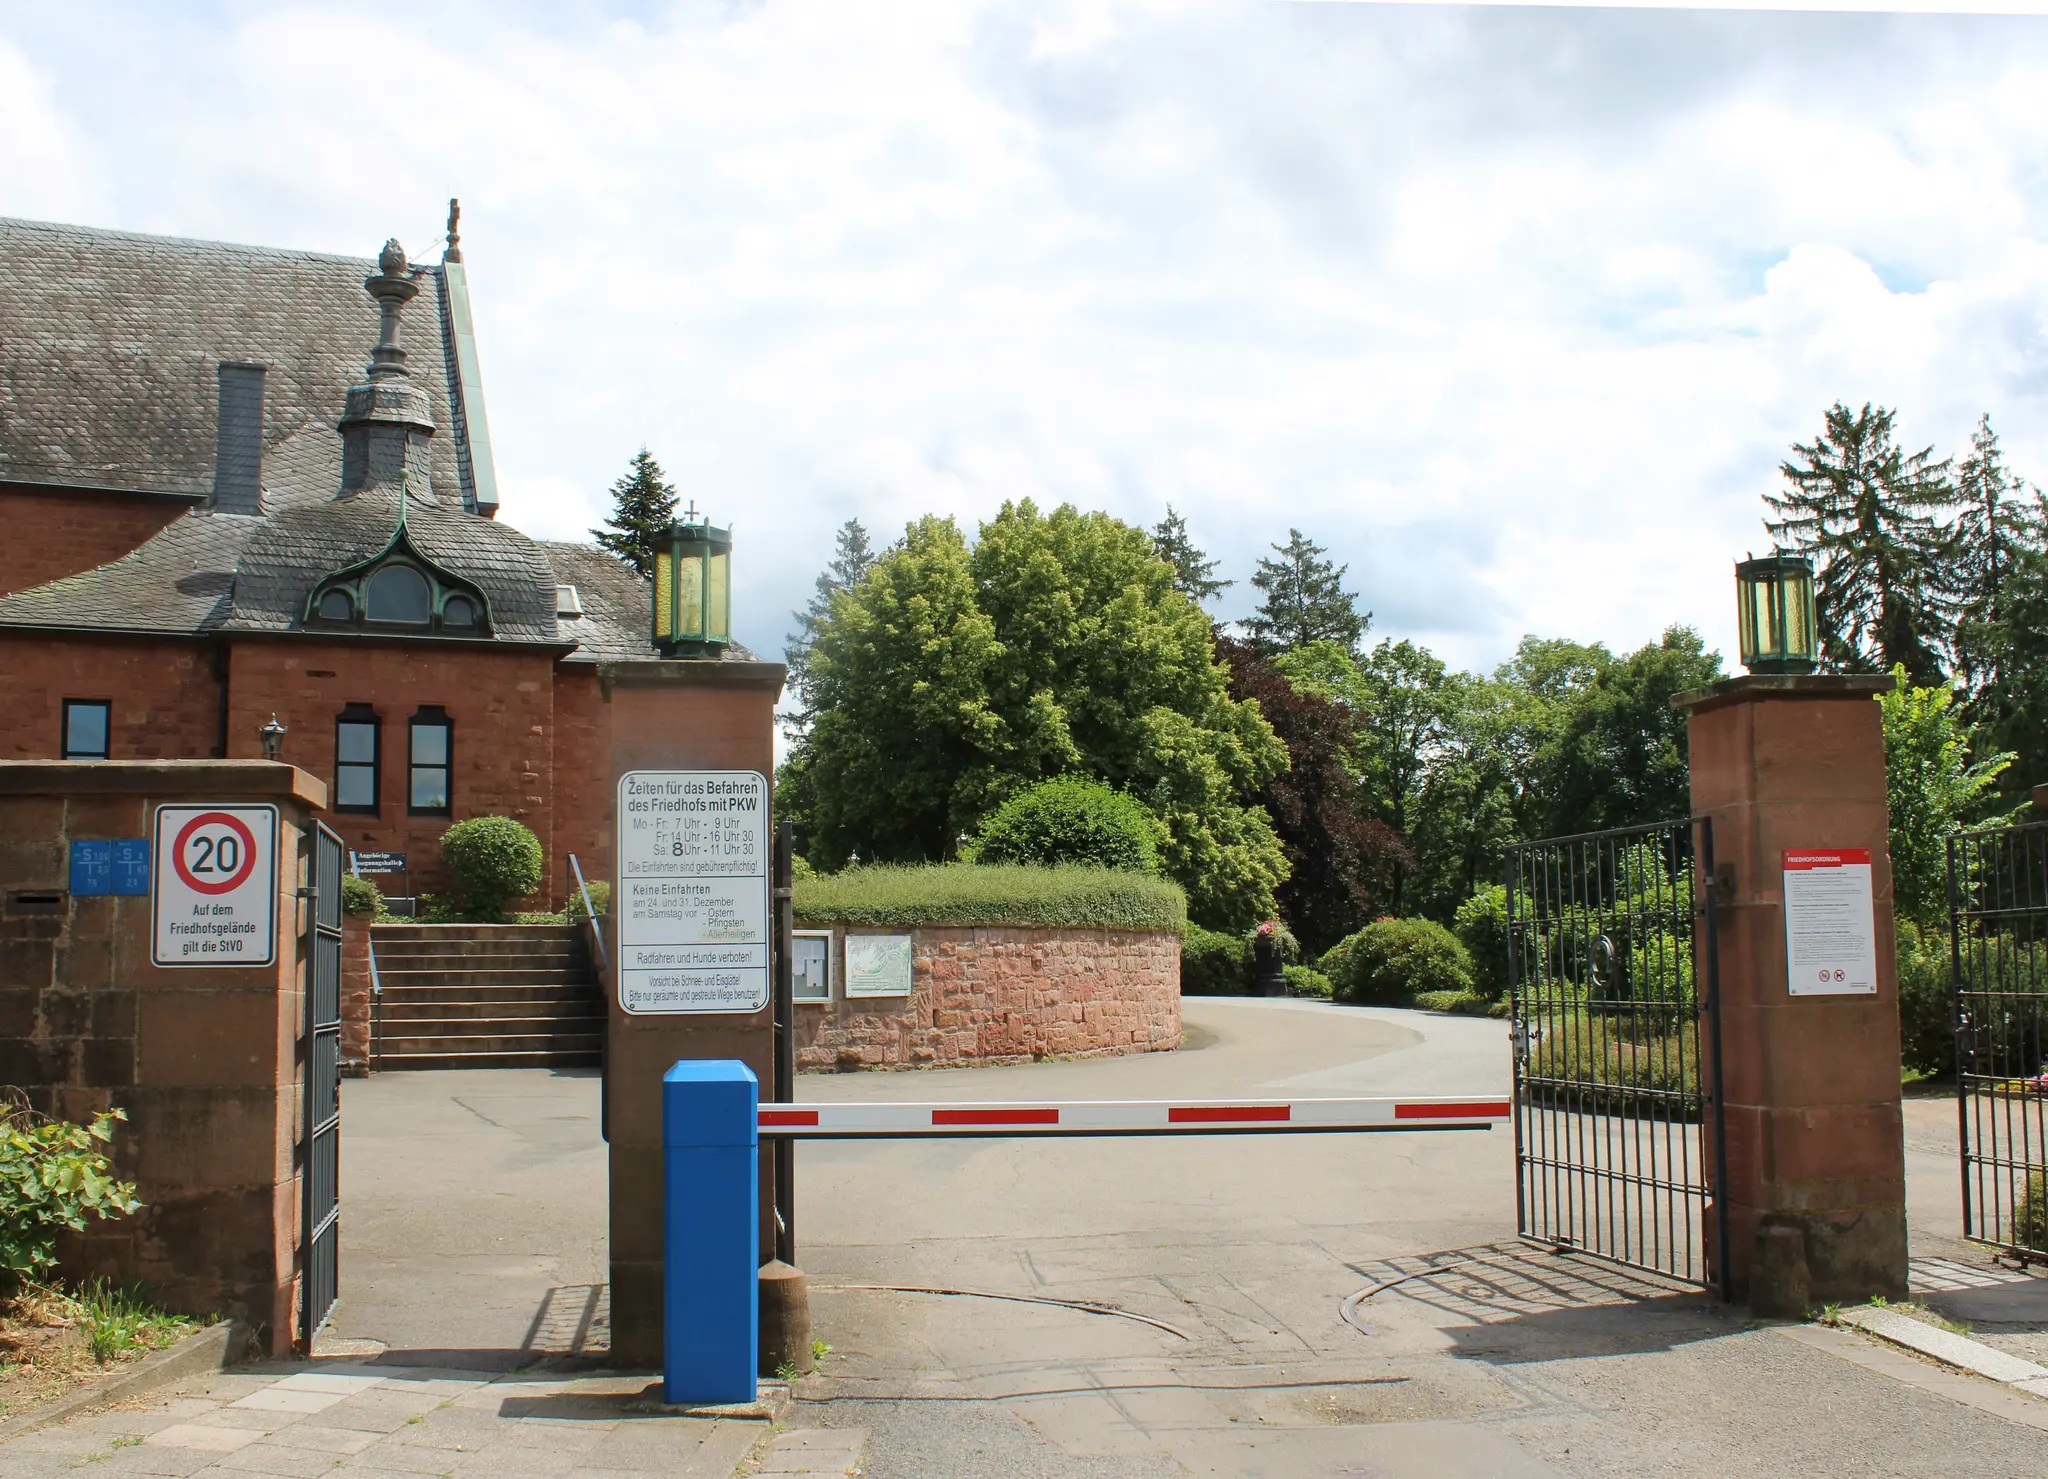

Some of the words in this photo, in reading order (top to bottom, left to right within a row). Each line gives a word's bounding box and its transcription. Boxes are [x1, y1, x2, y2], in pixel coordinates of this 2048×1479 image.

[628, 782, 663, 794] Zeiten
[666, 781, 682, 794] für
[684, 781, 704, 794] das
[707, 781, 757, 794] Befahren
[628, 799, 648, 812] des
[652, 798, 706, 811] Friedhofs
[709, 798, 727, 811] mit
[729, 798, 757, 810] PKW
[634, 818, 647, 829] Mo
[657, 818, 668, 829] Fr:
[675, 818, 681, 828] 7
[685, 818, 699, 829] Uhr
[715, 818, 720, 828] 9
[724, 818, 740, 829] Uhr
[657, 832, 668, 842] Fr:
[671, 832, 681, 842] 14
[685, 831, 700, 842] Uhr
[710, 831, 720, 842] 16
[724, 831, 740, 842] Uhr
[743, 831, 753, 841] 30
[192, 836, 238, 872] 20
[654, 845, 668, 855] Sa:
[672, 842, 683, 856] 8
[685, 844, 700, 855] Uhr
[711, 844, 719, 855] 11
[724, 844, 740, 855] Uhr
[743, 844, 753, 855] 30
[628, 862, 640, 872] Die
[643, 862, 678, 872] Einfahrten
[680, 861, 695, 872] sind
[696, 861, 757, 874] gebührenpflichtig!
[633, 885, 659, 895] Keine
[662, 885, 710, 894] Einfahrten
[648, 898, 659, 907] 24.
[663, 898, 677, 907] und
[680, 898, 691, 907] 31.
[694, 898, 734, 906] Dezember
[193, 904, 209, 915] Auf
[212, 904, 233, 915] dem
[648, 909, 682, 920] Samstag
[708, 908, 734, 917] Ostern
[170, 922, 256, 936] Friedhofsgelände
[708, 918, 744, 929] Pfingsten
[708, 929, 755, 940] Allerheiligen
[183, 941, 198, 955] gilt
[202, 941, 216, 951] die
[220, 940, 242, 951] StVO
[638, 953, 675, 964] Radfahren
[677, 952, 690, 963] und
[693, 952, 716, 963] Hunde
[718, 951, 752, 962] verboten!
[649, 975, 671, 986] Vorsicht
[672, 975, 680, 986] bei
[682, 975, 703, 986] Schnee-
[703, 975, 715, 985] und
[716, 974, 740, 988] Eisglätte!
[630, 990, 641, 1001] Bitte
[643, 992, 651, 1001] nur
[653, 990, 678, 1003] geräumte
[680, 990, 690, 1001] und
[691, 991, 716, 1003] gestreute
[717, 990, 733, 1002] Wege
[734, 990, 760, 999] benutzen!
